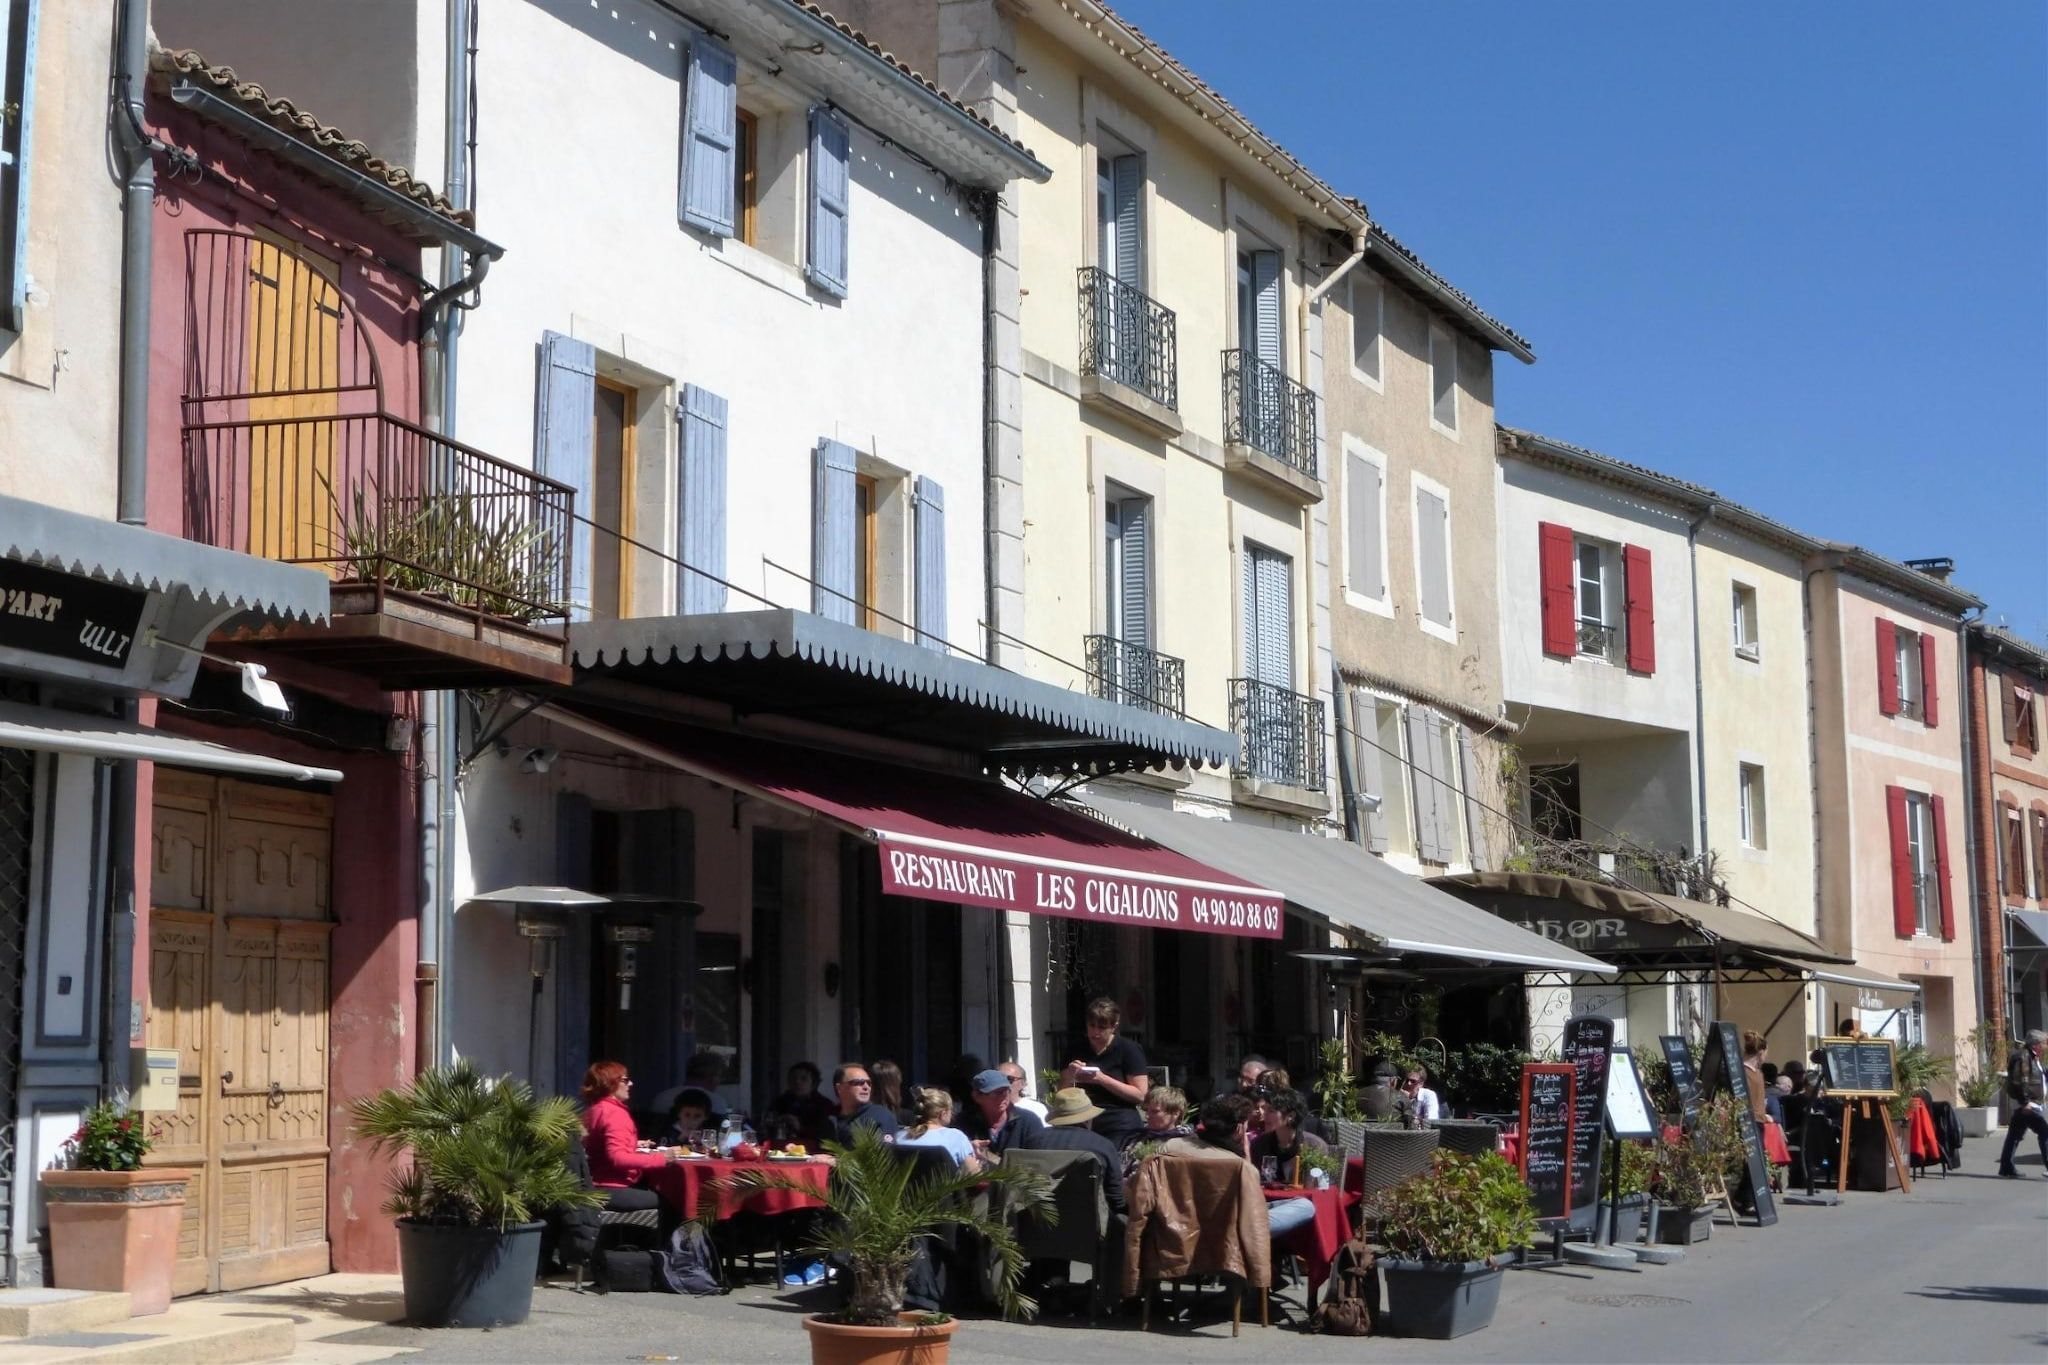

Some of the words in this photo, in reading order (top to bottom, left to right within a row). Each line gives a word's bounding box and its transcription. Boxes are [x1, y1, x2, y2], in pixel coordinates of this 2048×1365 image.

[889, 850, 1016, 901] RESTAURANT
[1036, 872, 1076, 911] LES
[1085, 878, 1179, 922] CIGALONS
[1192, 896, 1209, 924] 04
[1210, 898, 1228, 926] 90
[1229, 900, 1244, 927] 20
[1247, 902, 1261, 929] 88
[1264, 905, 1279, 931] 03
